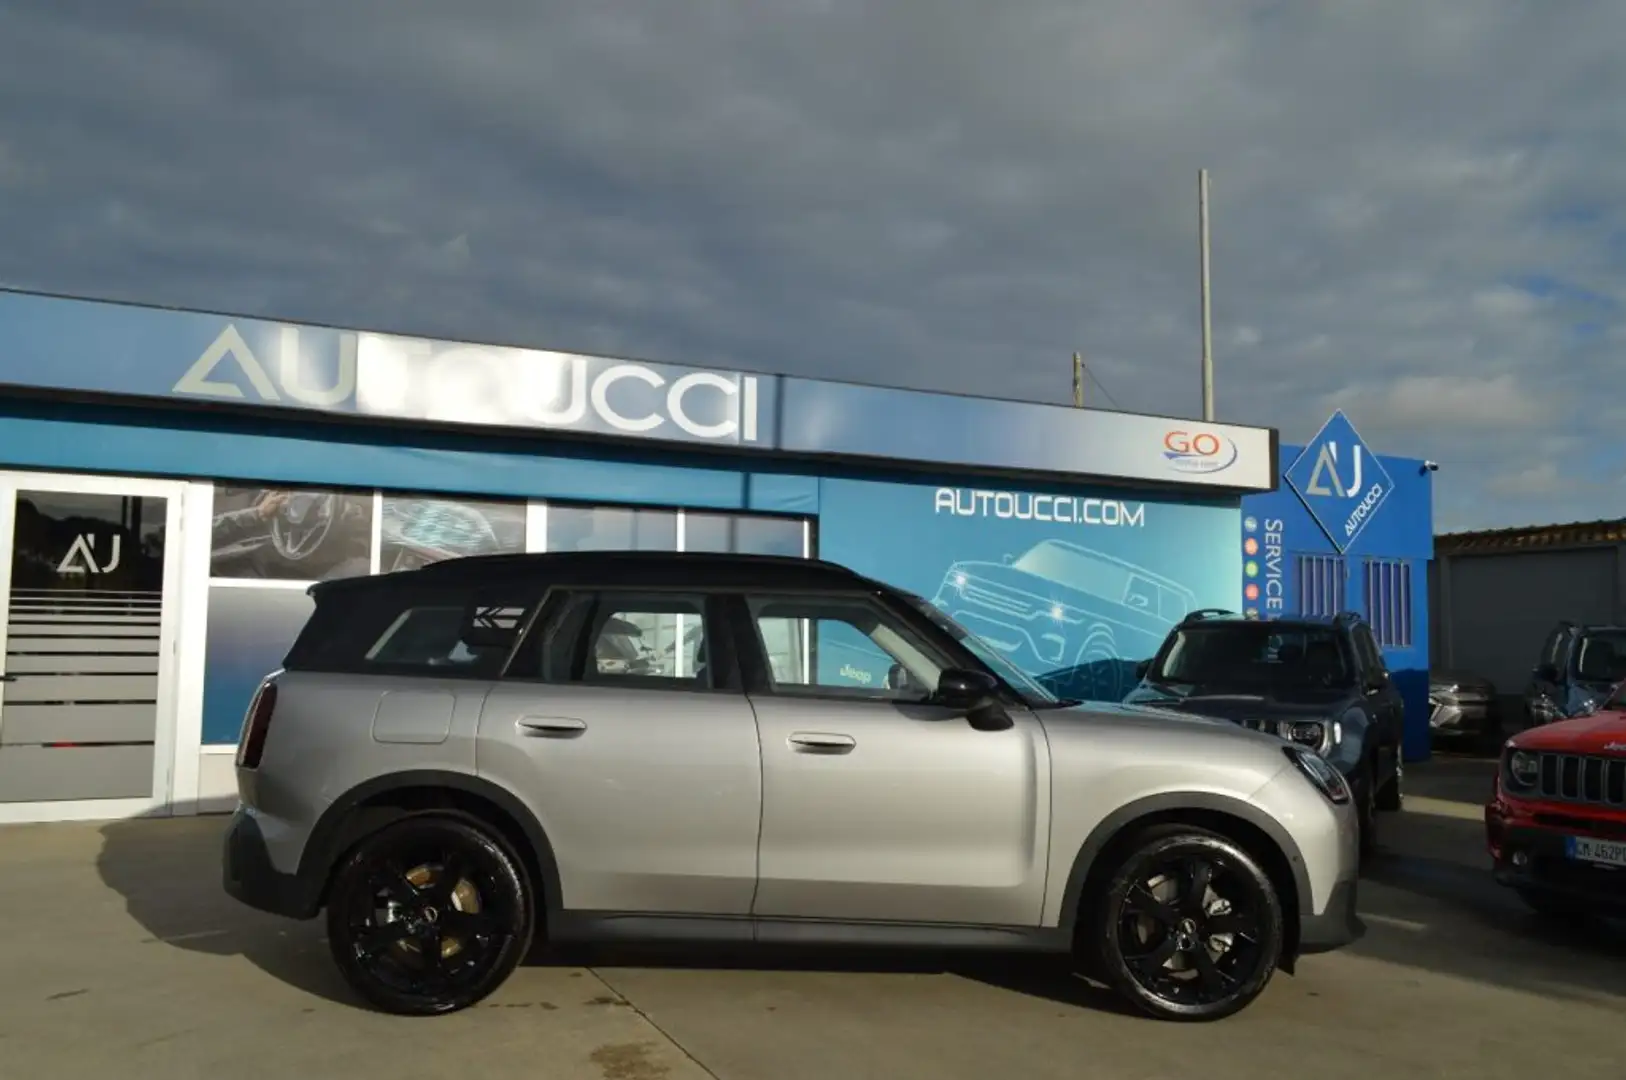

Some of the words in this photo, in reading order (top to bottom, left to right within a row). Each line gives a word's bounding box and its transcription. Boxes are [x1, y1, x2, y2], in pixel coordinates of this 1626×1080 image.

[1163, 430, 1220, 456] GO
[934, 487, 1145, 527] AUTOUCCI.COM
[1264, 519, 1283, 609] SERVICE
